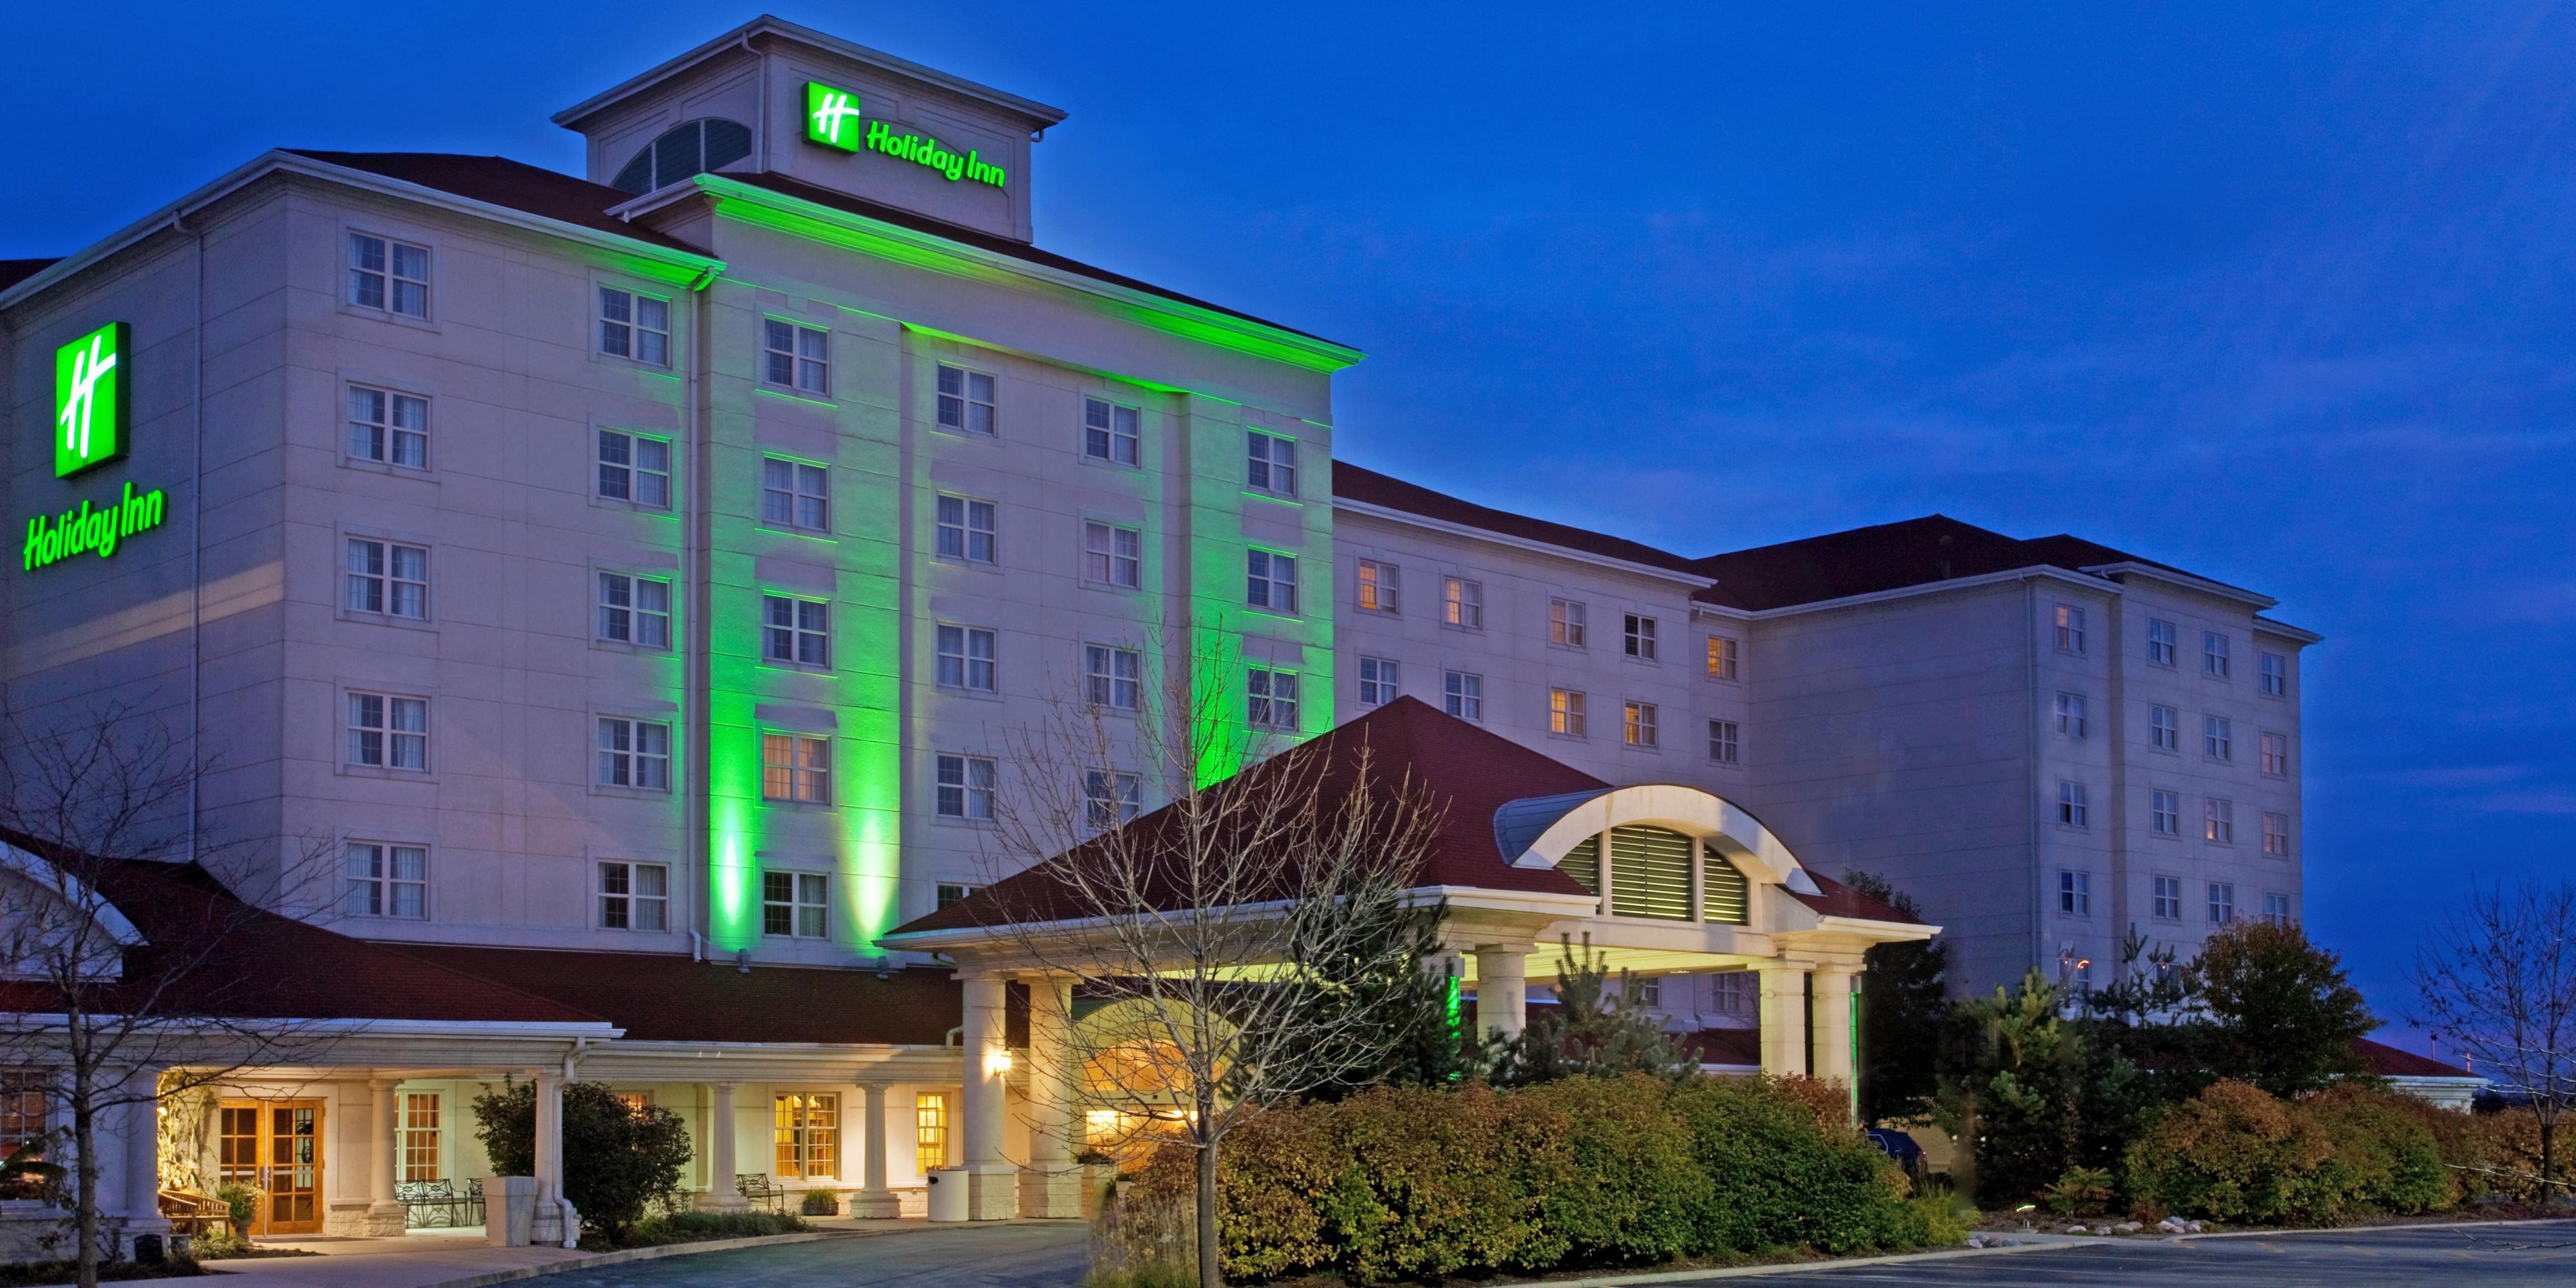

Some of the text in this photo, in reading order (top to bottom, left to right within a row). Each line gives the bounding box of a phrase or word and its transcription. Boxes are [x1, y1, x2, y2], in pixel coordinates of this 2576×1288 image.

[867, 120, 1005, 187] Holiday Inn
[24, 482, 162, 571] Holiday Inn
